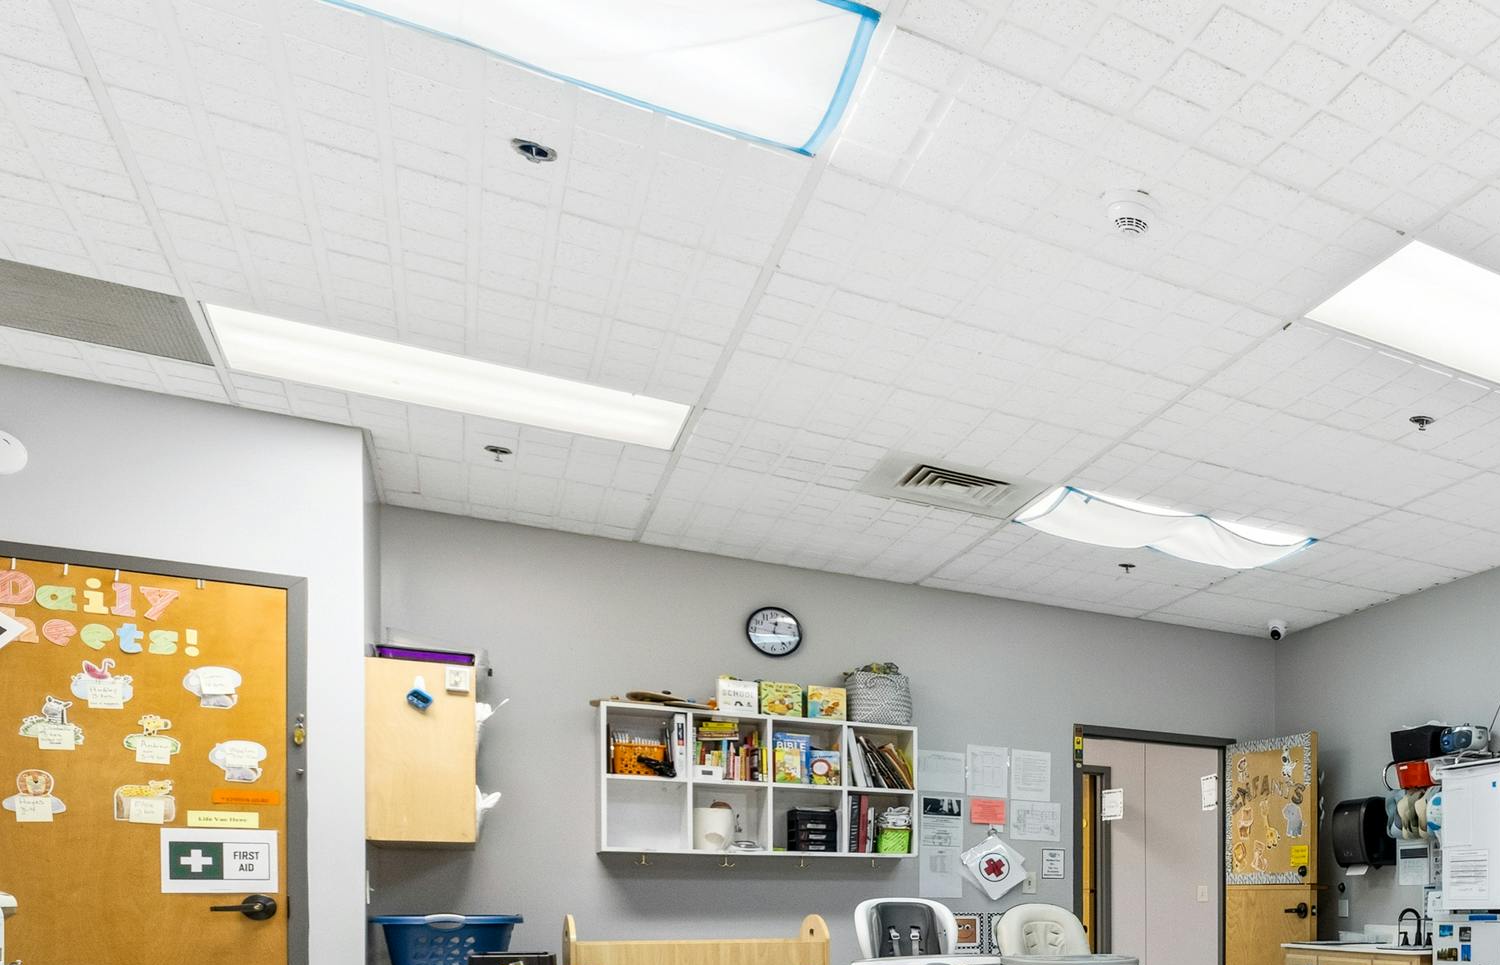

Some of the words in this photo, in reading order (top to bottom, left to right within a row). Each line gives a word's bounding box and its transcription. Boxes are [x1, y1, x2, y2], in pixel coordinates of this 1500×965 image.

[0, 570, 180, 621] Daily
[776, 741, 807, 751] BIBLE
[233, 851, 260, 861] FIRST
[238, 864, 255, 873] AID
